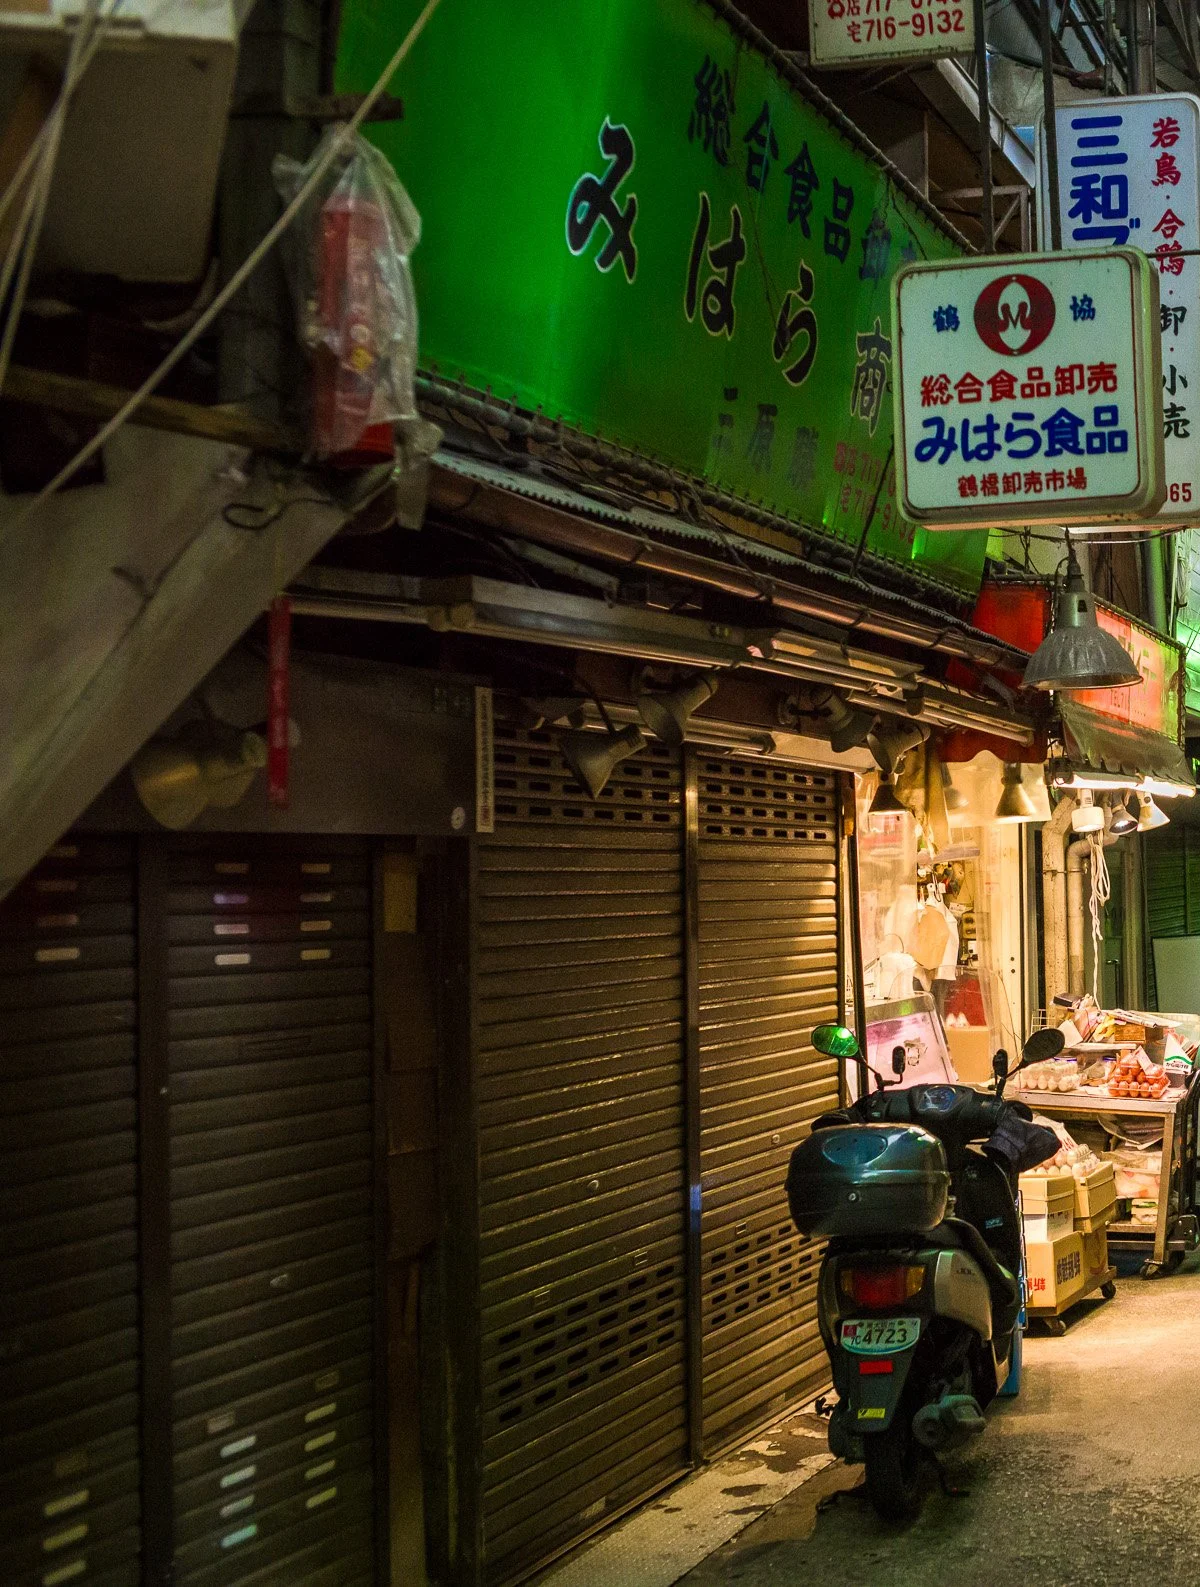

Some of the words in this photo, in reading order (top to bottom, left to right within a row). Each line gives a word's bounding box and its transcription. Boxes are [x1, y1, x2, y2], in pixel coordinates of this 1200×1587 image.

[847, 9, 965, 43] 宅716-9132
[565, 115, 893, 437] みはら商
[920, 361, 1118, 407] 総合食品卸売
[914, 404, 1129, 465] みはら食品
[957, 466, 1088, 498] 鶴橋卸売市場
[1165, 482, 1192, 503] 65
[862, 1328, 908, 1345] 4723
